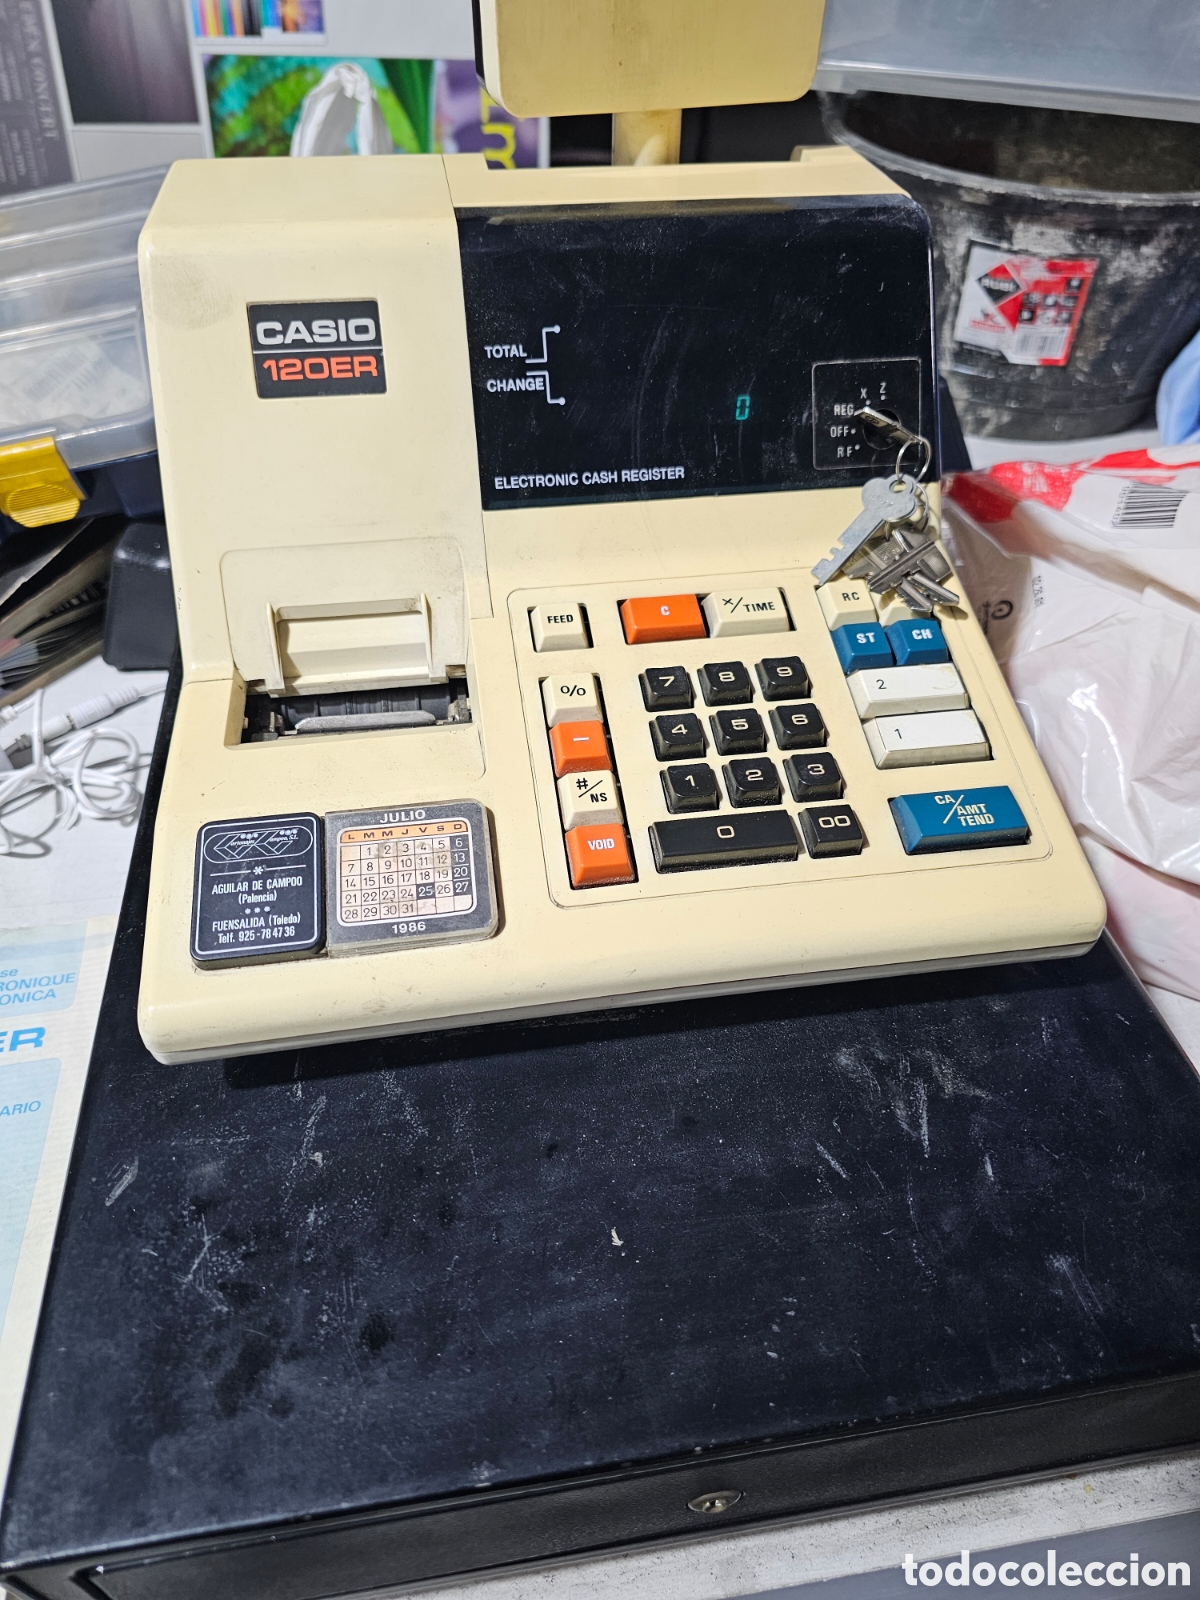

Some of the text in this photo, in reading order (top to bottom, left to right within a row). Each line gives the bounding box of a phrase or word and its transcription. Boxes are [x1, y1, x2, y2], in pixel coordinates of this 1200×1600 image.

[255, 318, 376, 345] CASIO
[484, 344, 527, 359] TOTAL
[263, 355, 378, 381] 120ER
[487, 377, 544, 393] CHANGE
[879, 382, 887, 393] Z
[860, 388, 868, 399] X
[736, 394, 750, 420] 0
[834, 404, 854, 415] REG
[830, 427, 849, 438] OFF
[494, 466, 685, 489] ELECTRONIC CASH REGISTER
[841, 592, 860, 601] RC
[660, 606, 670, 616] C
[547, 614, 574, 624] FEED
[856, 633, 875, 643] ST
[912, 629, 933, 640] CH
[659, 666, 793, 687] 7 8 9
[876, 679, 887, 690] 2
[671, 714, 809, 735] 4 5 6
[894, 728, 903, 739] 1
[684, 764, 825, 787] 1 2 3
[380, 810, 425, 823] JULIO
[958, 814, 994, 827] TEND
[716, 826, 735, 839] 0
[367, 847, 371, 855] 1
[384, 845, 391, 855] 2
[402, 844, 409, 852] 3
[438, 840, 445, 849] 5
[455, 838, 462, 847] 6
[587, 838, 615, 850] VOID
[348, 853, 466, 873] 7 8 9 10 11 12 13
[346, 867, 468, 888] 14 15 16 17 18 19 20
[212, 876, 302, 895] AGUILAR DE CAMPOO
[238, 890, 277, 904] (Palencia)
[345, 882, 468, 904] 21 22 23 24 25 26 27
[344, 904, 414, 920] 28 29 30 31
[212, 912, 300, 932] FUENSALIDA (Toledo)
[392, 922, 426, 934] 1986
[218, 933, 235, 944] Telf.
[0, 1100, 42, 1117] ARIO
